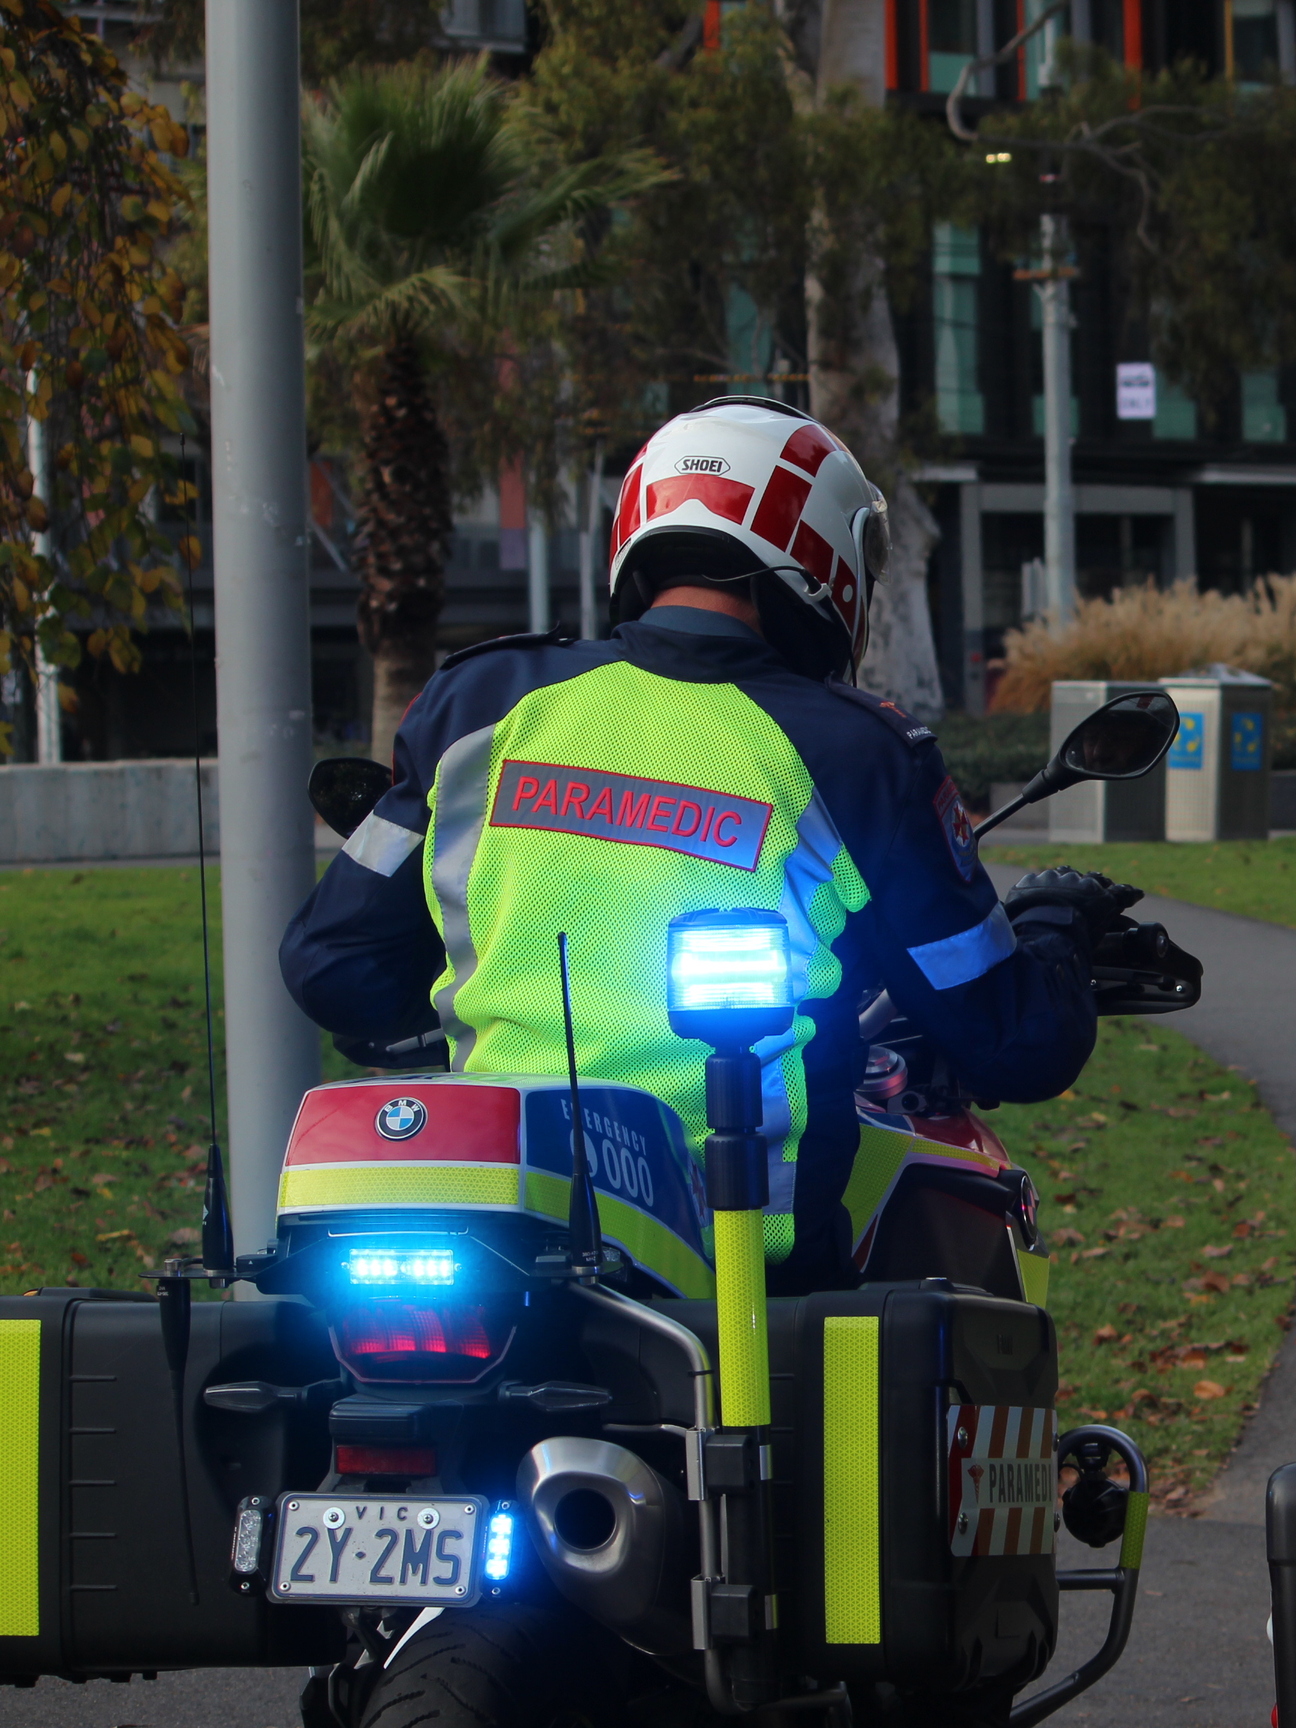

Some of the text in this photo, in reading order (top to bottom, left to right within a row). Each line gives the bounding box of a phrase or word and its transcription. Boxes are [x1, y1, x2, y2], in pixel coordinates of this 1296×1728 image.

[681, 458, 723, 473] SHOEI
[512, 775, 743, 848] PARAMEDIC
[560, 1099, 647, 1157] EERGENCY
[602, 1138, 654, 1208] 000
[989, 1463, 1052, 1503] PARAMEDI
[356, 1505, 409, 1521] VIC
